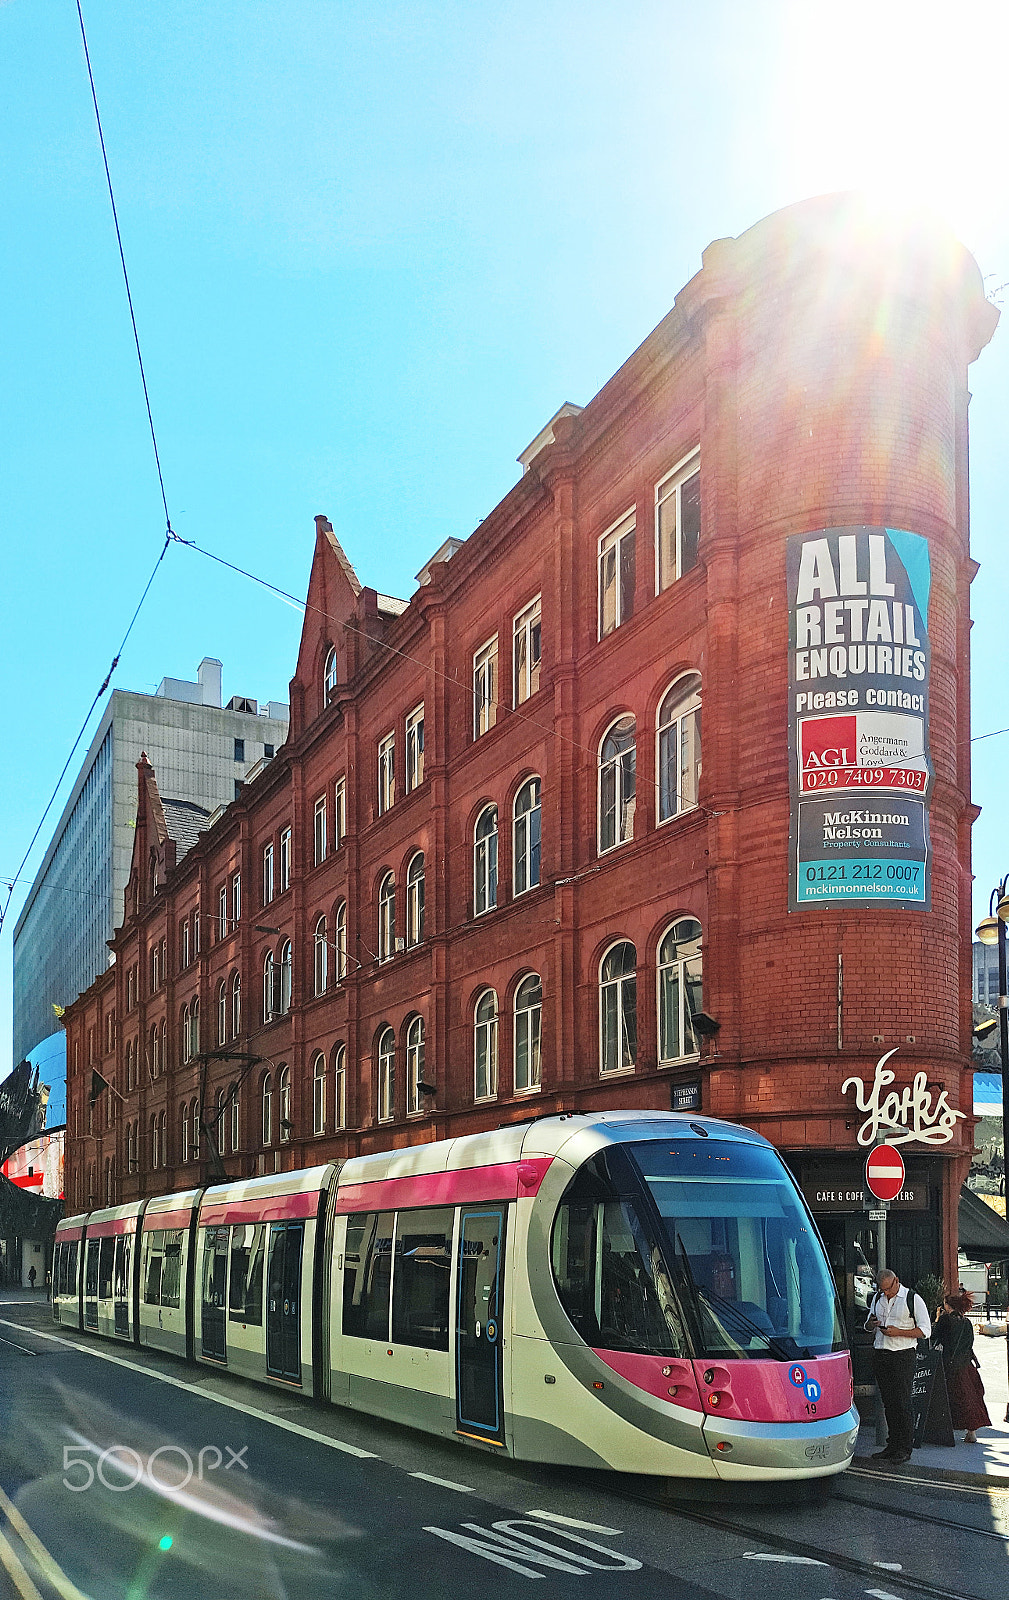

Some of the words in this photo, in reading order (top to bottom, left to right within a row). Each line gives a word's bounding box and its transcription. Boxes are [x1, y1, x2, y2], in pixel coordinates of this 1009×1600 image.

[796, 535, 895, 605] ALL
[796, 599, 921, 649] RETAIL
[796, 645, 926, 681] ENQUIRIES
[796, 689, 859, 713] Please
[866, 688, 924, 713] contact
[860, 733, 908, 747] Angermann
[804, 748, 856, 769] AGL
[860, 745, 899, 757] Goddard
[900, 748, 908, 758] &
[807, 770, 838, 787] 020
[845, 769, 884, 785] 7409
[889, 770, 922, 787] 7303
[823, 810, 909, 826] McKinnon
[823, 826, 882, 840] Nelson
[823, 840, 861, 849] Property
[863, 839, 910, 848] Consultants
[806, 865, 847, 881] 0121
[852, 864, 882, 879] 212
[886, 865, 920, 882] 0007
[806, 881, 919, 895] mckinnonnelson.co.uk
[841, 1046, 967, 1146] Yorks
[816, 1191, 835, 1201] CAFE
[838, 1191, 843, 1201] &
[846, 1191, 864, 1201] COFF
[805, 1403, 817, 1415] 19
